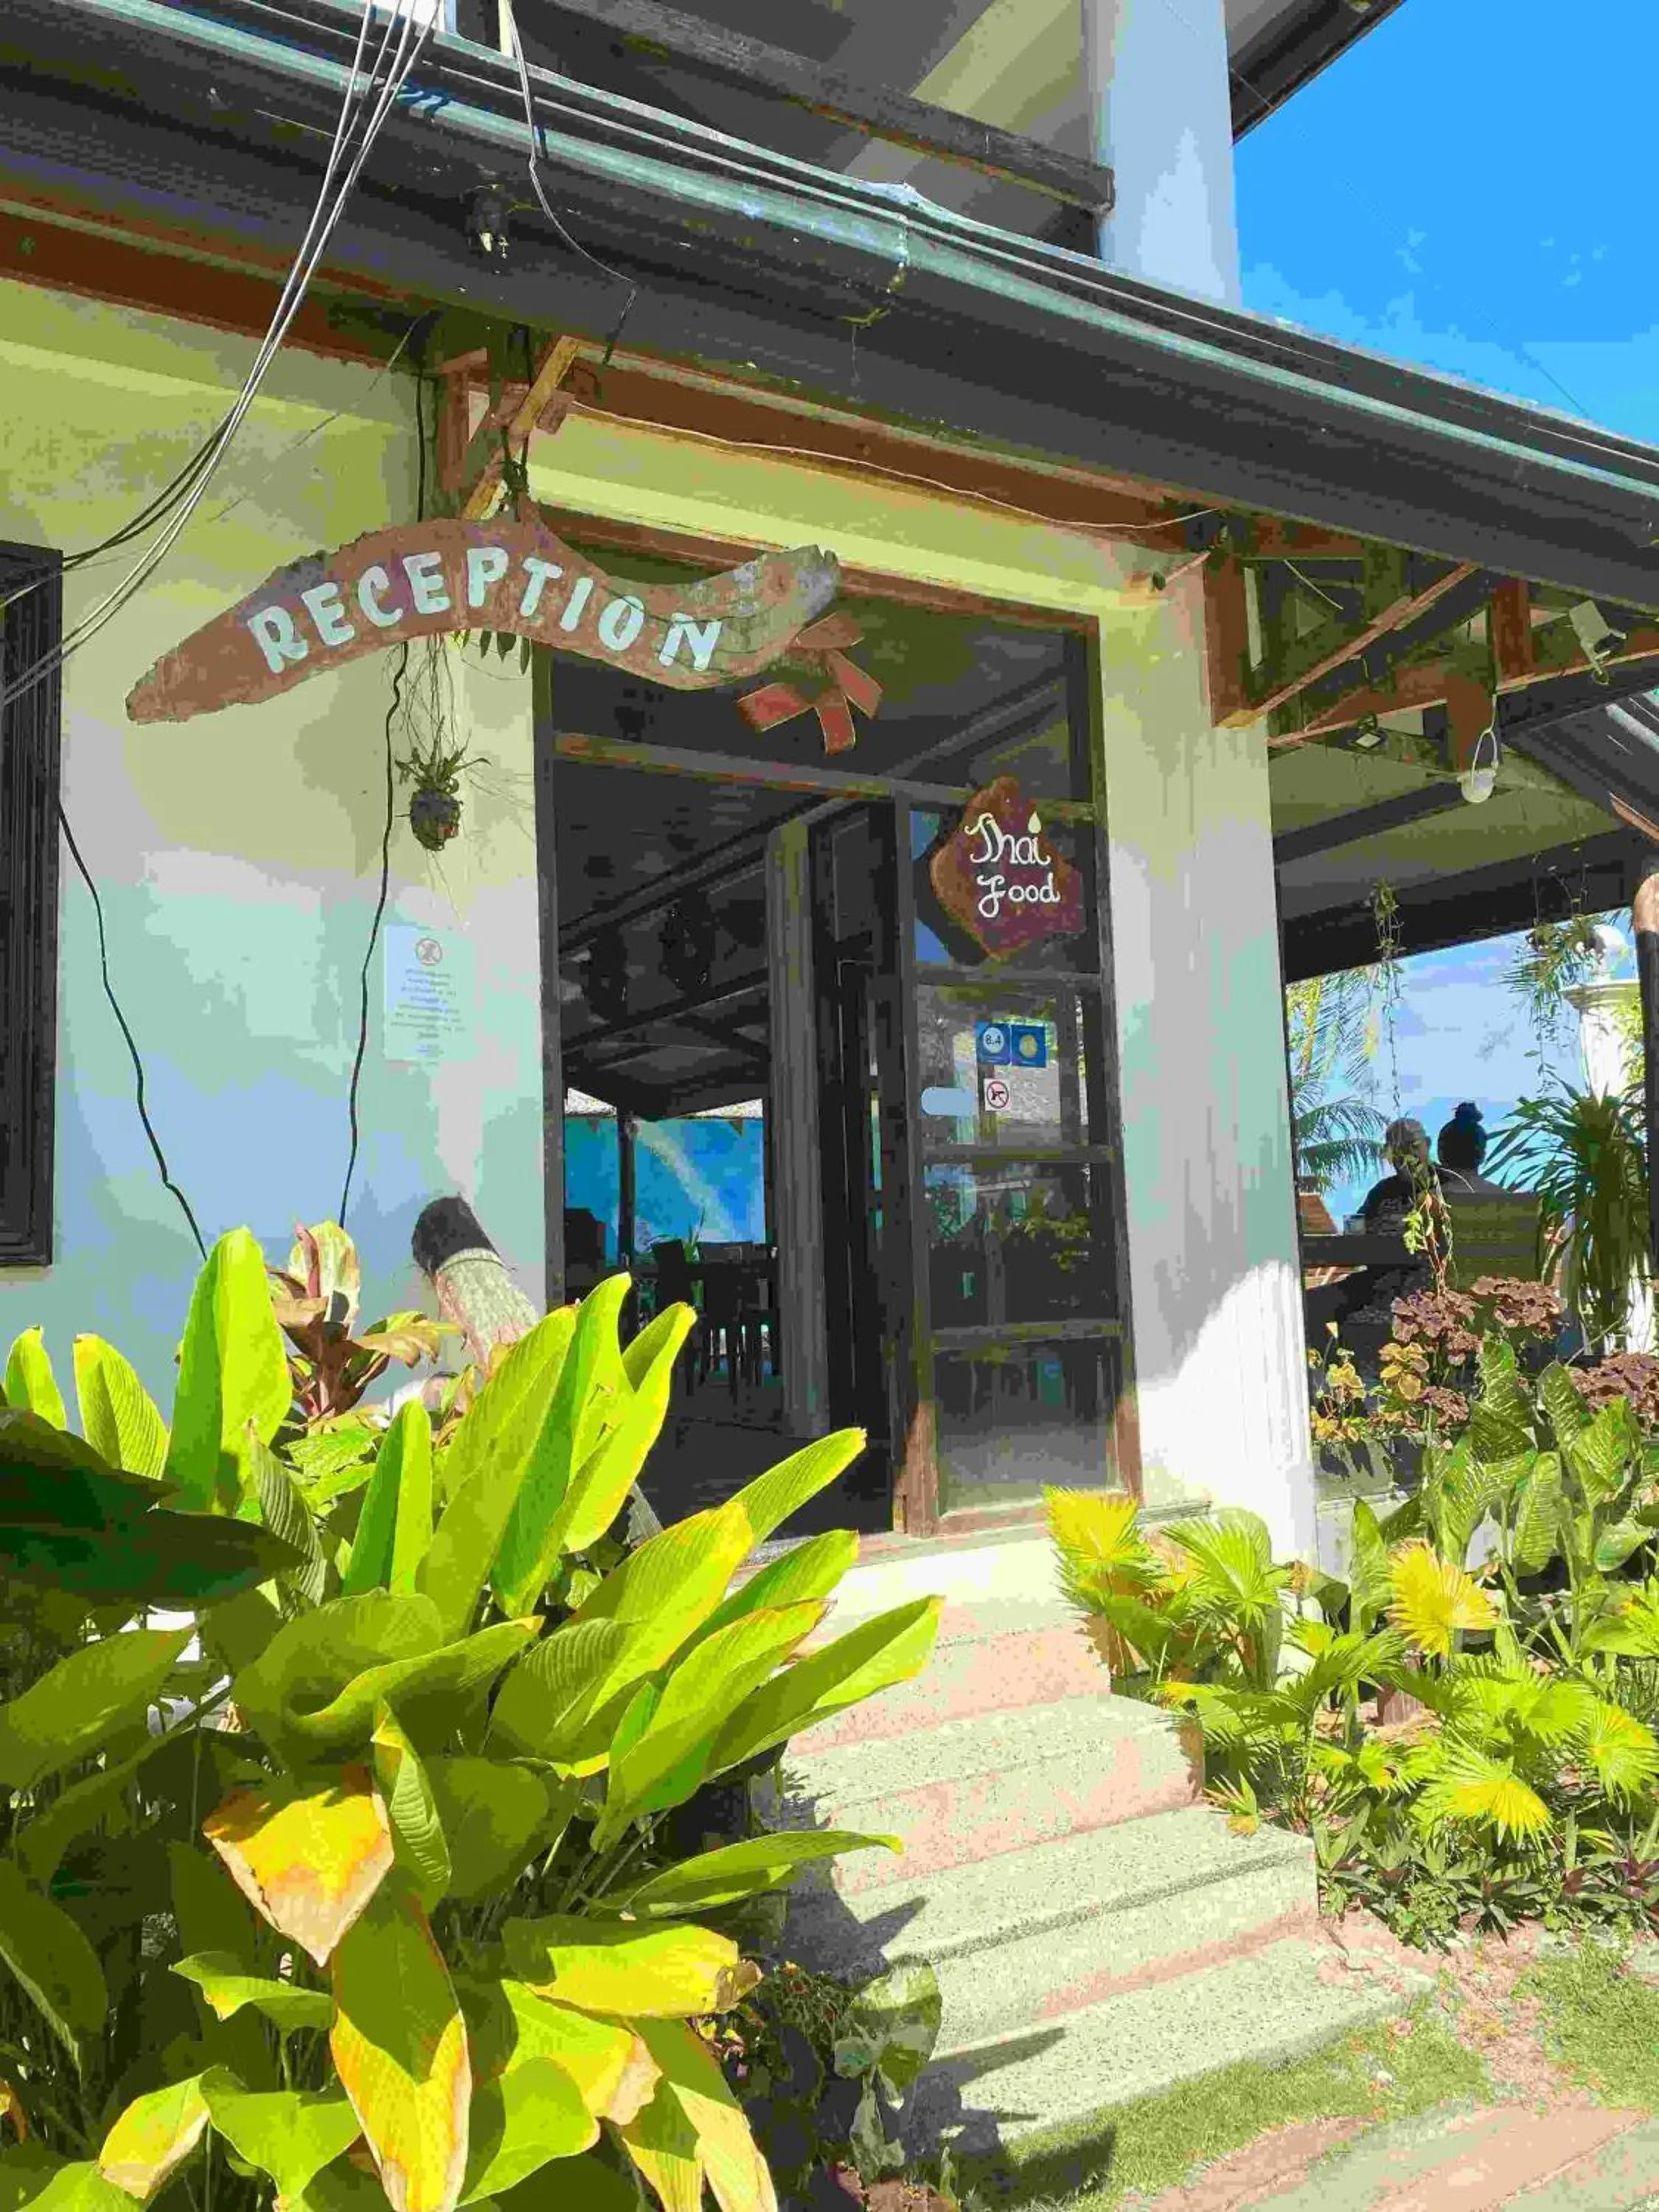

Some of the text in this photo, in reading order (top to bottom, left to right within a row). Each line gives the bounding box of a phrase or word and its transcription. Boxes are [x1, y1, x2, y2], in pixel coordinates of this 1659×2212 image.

[246, 546, 724, 672] RECEPTION
[964, 812, 1051, 865] Thai
[977, 872, 1061, 918] Food
[986, 1034, 1001, 1045] 8.4
